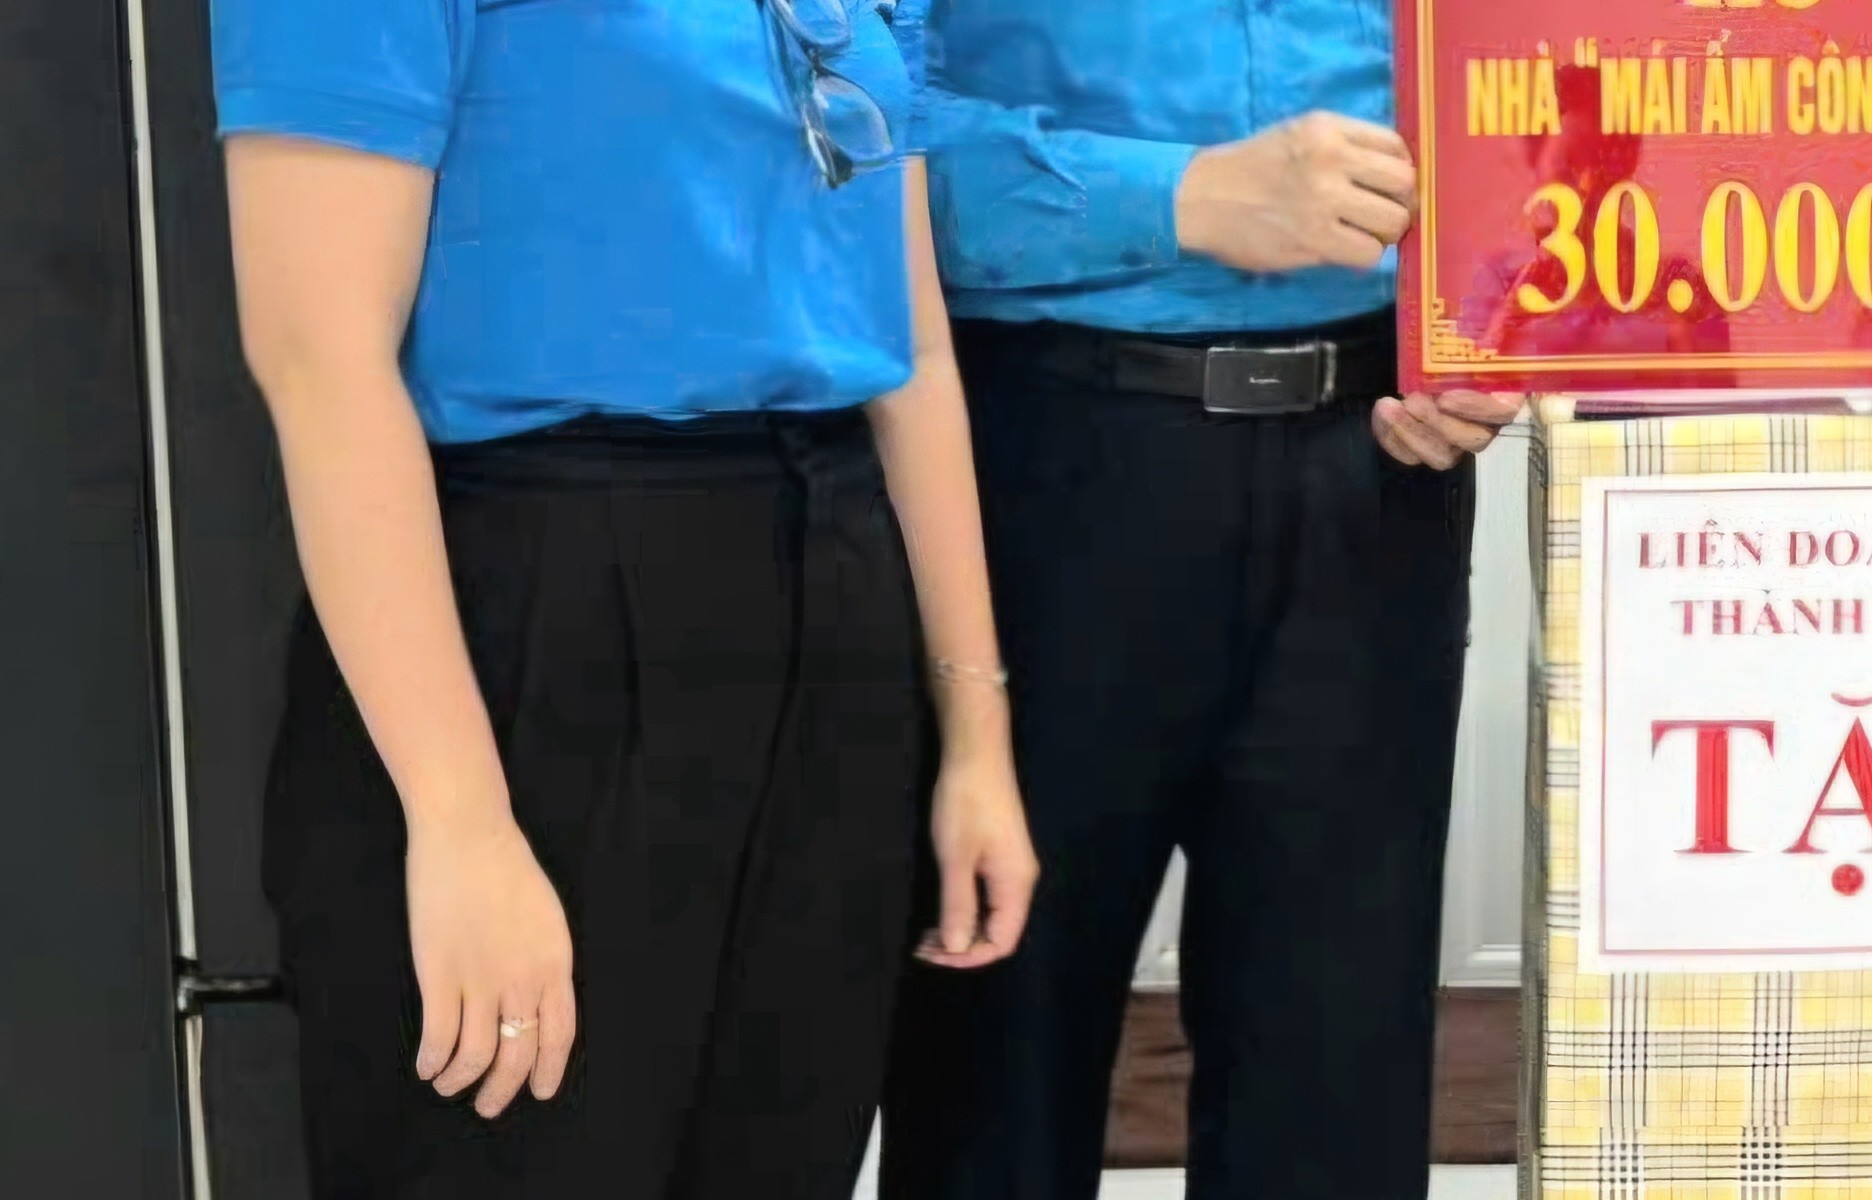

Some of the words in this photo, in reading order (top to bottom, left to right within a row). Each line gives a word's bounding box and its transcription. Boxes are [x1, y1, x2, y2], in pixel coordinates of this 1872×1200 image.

[1467, 39, 1561, 135] NHÀ
[1638, 519, 1763, 569] LIÊN
[1670, 588, 1864, 636] THÀNH
